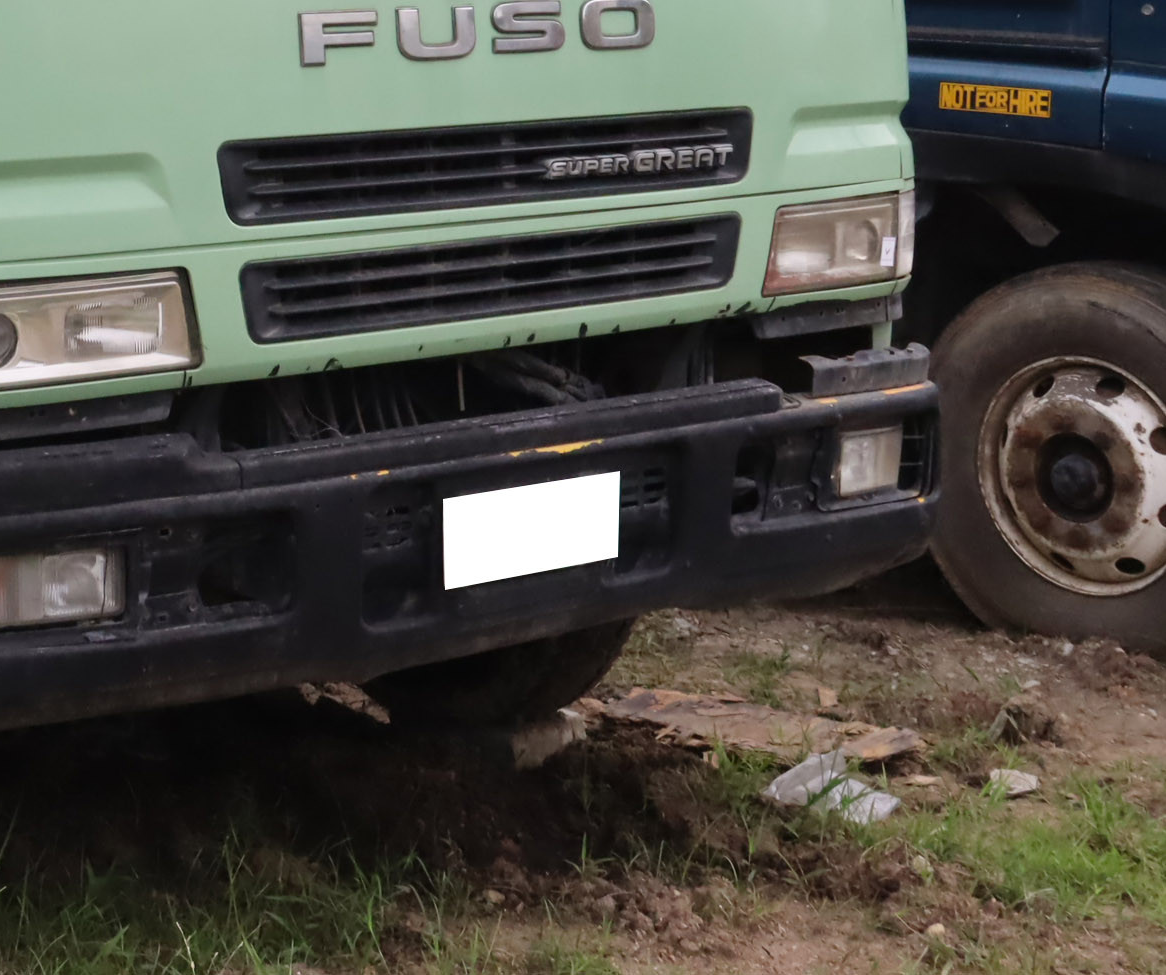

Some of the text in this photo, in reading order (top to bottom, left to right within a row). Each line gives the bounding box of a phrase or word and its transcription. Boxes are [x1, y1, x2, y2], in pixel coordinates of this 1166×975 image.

[941, 83, 1050, 116] NOT FOR HIRE
[547, 144, 734, 179] SUPER GREAT
